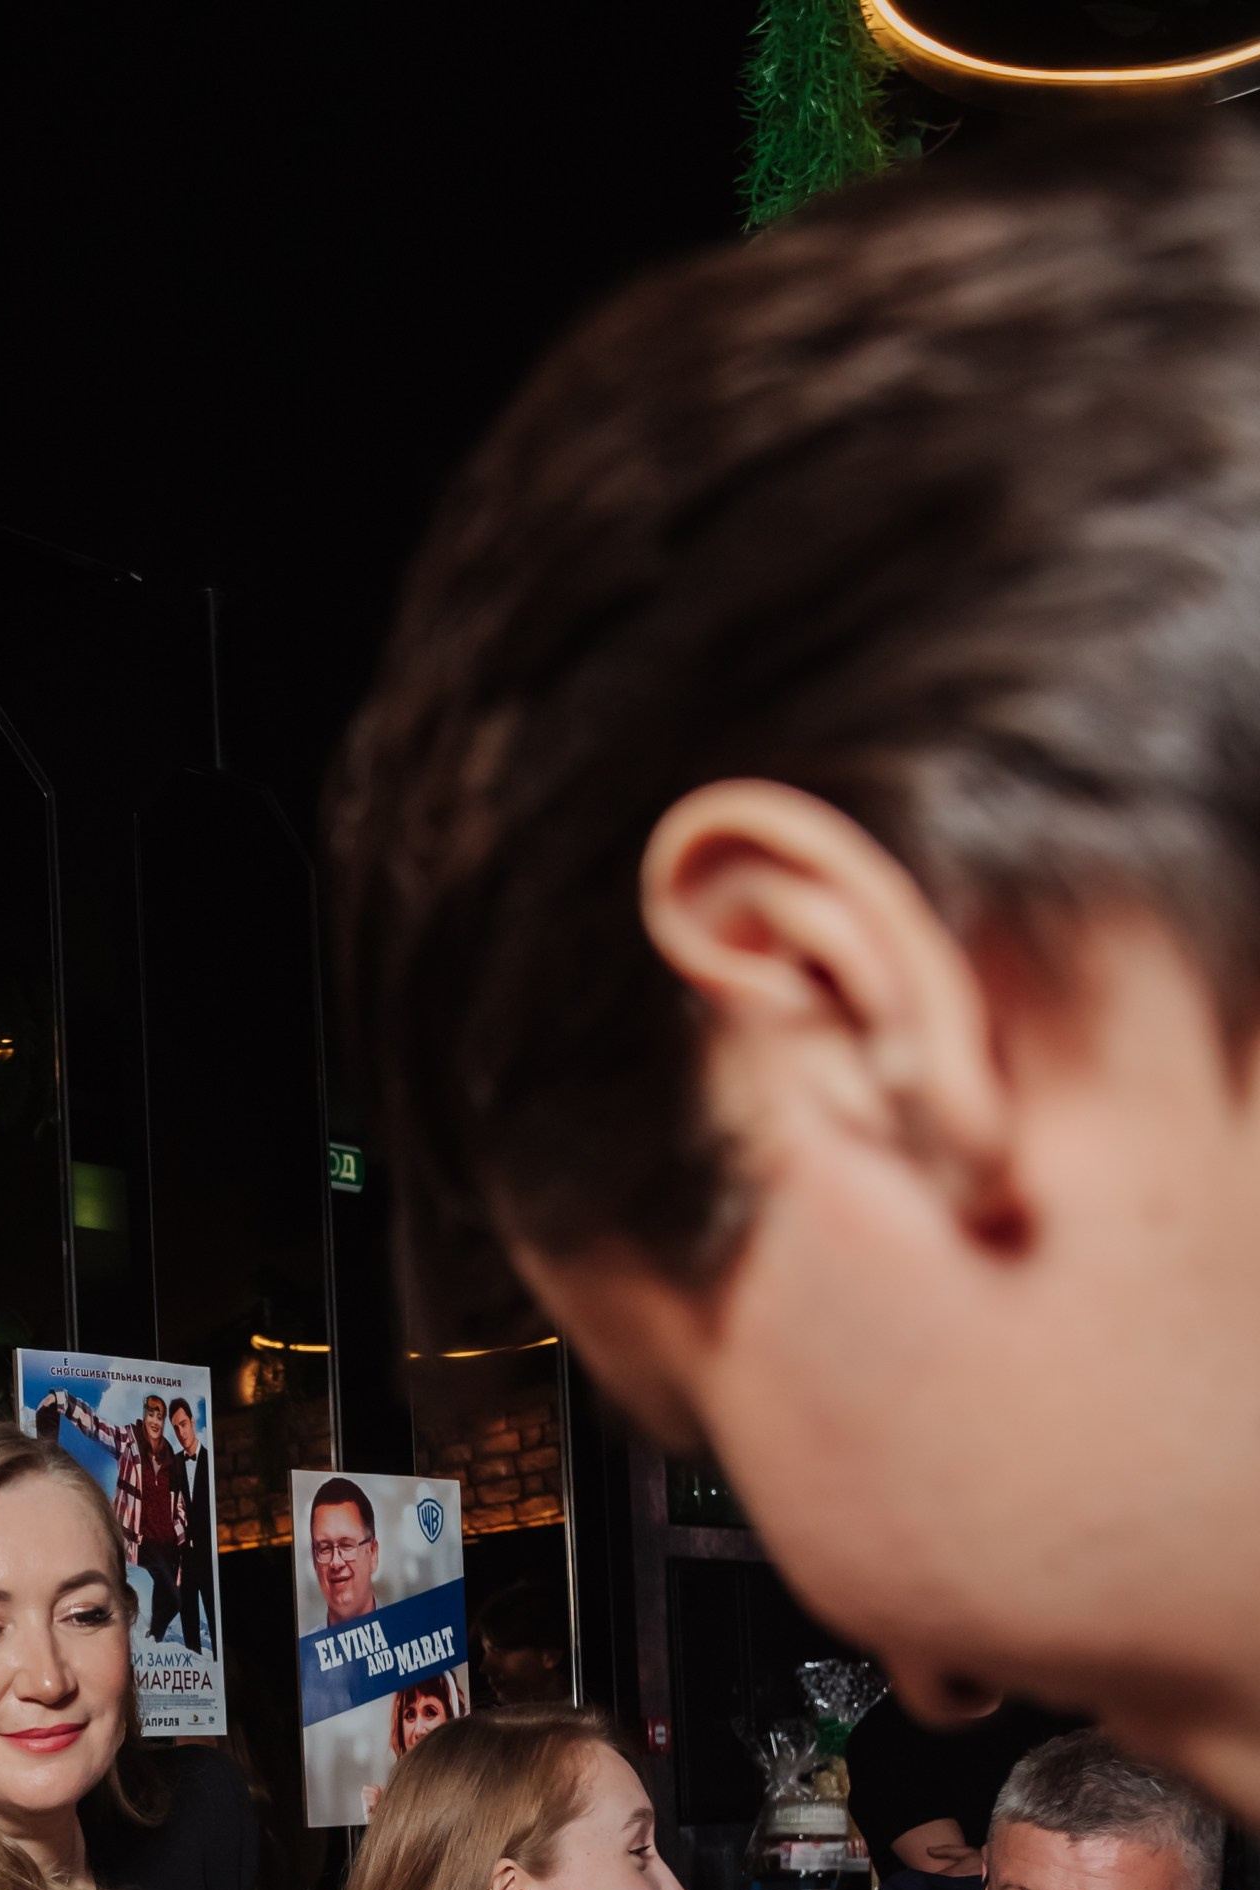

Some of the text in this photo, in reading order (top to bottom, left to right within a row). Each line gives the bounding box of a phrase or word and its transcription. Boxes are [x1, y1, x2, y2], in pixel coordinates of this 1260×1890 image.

[145, 1376, 182, 1388] КОМЕДИЯ
[314, 1620, 388, 1672] ELVINA
[366, 1626, 456, 1677] AND MARAT
[147, 1652, 193, 1667] ЗАМУЖ
[144, 1717, 180, 1727] АПРЕЛЯ
